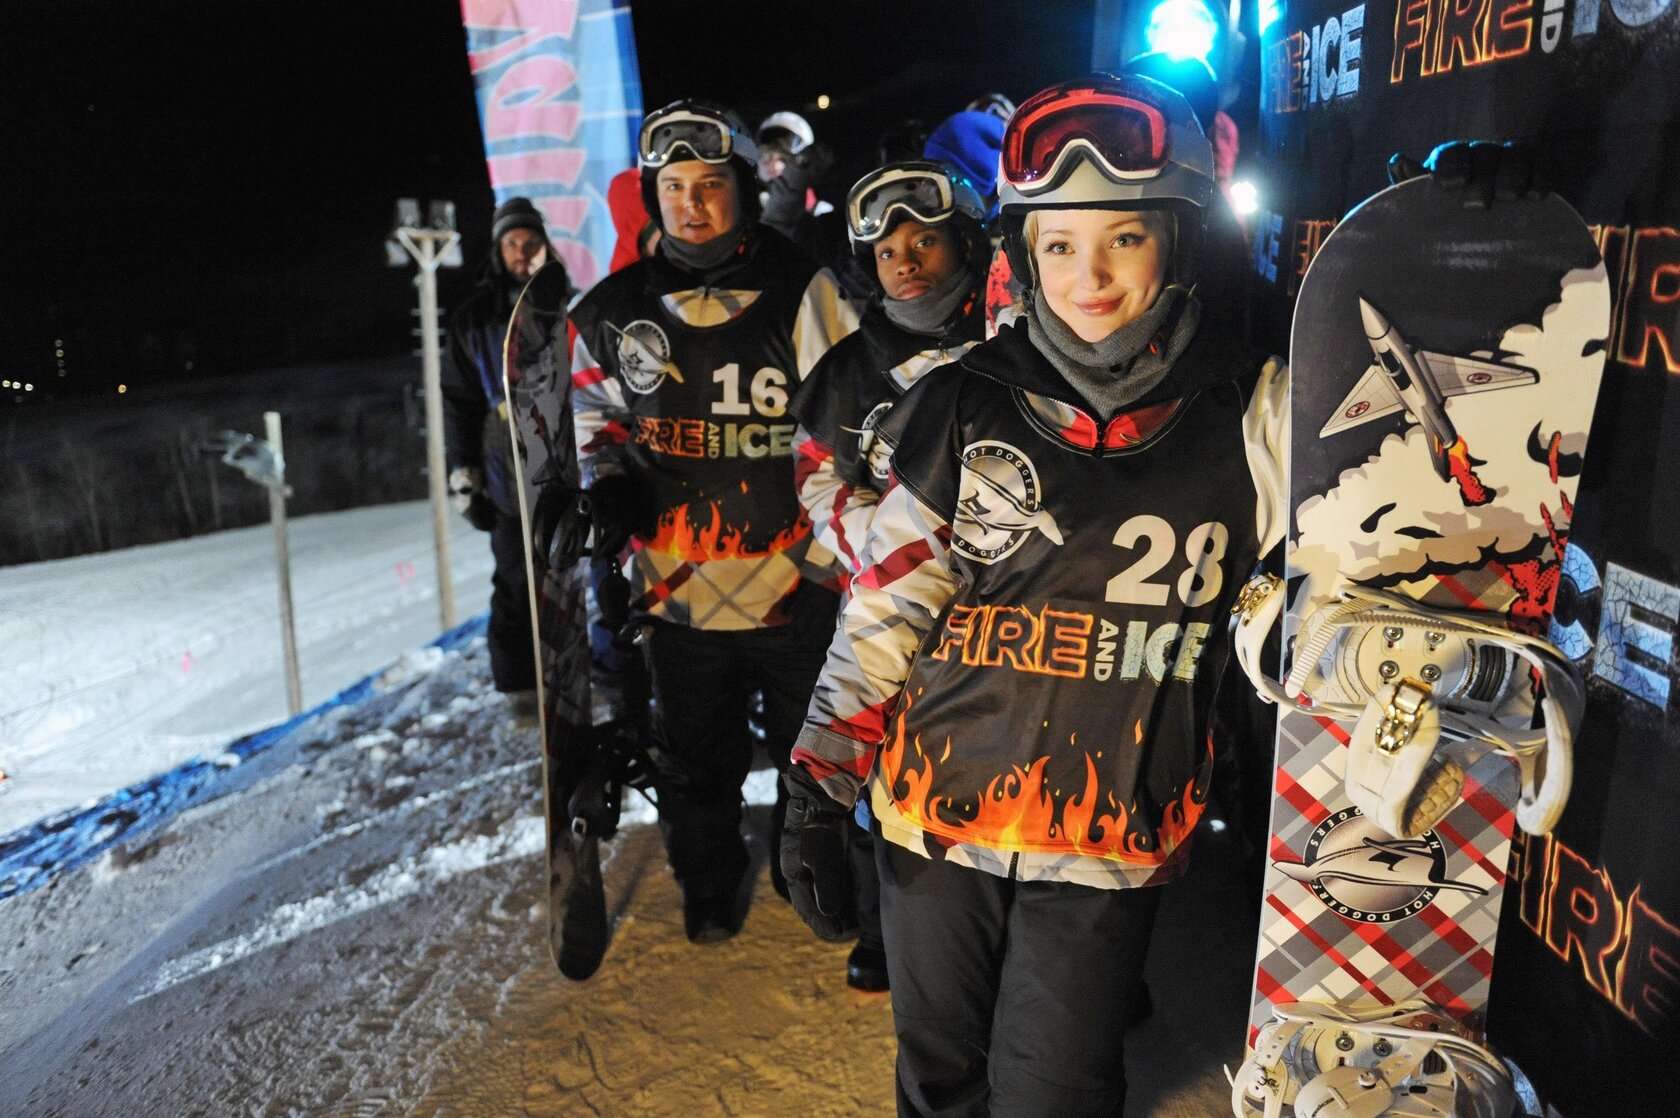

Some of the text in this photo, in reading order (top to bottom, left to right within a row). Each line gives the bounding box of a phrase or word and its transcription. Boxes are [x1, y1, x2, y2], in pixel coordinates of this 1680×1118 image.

[1309, 4, 1365, 104] ICE
[711, 362, 789, 418] 16
[707, 422, 720, 460] AND
[724, 423, 796, 459] ICE
[996, 448, 1035, 506] DOGGERS
[1105, 514, 1229, 608] 28
[931, 602, 1212, 687] FIRE AND ICE
[1310, 807, 1441, 850] HO GGERS
[1404, 890, 1434, 916] HOT
